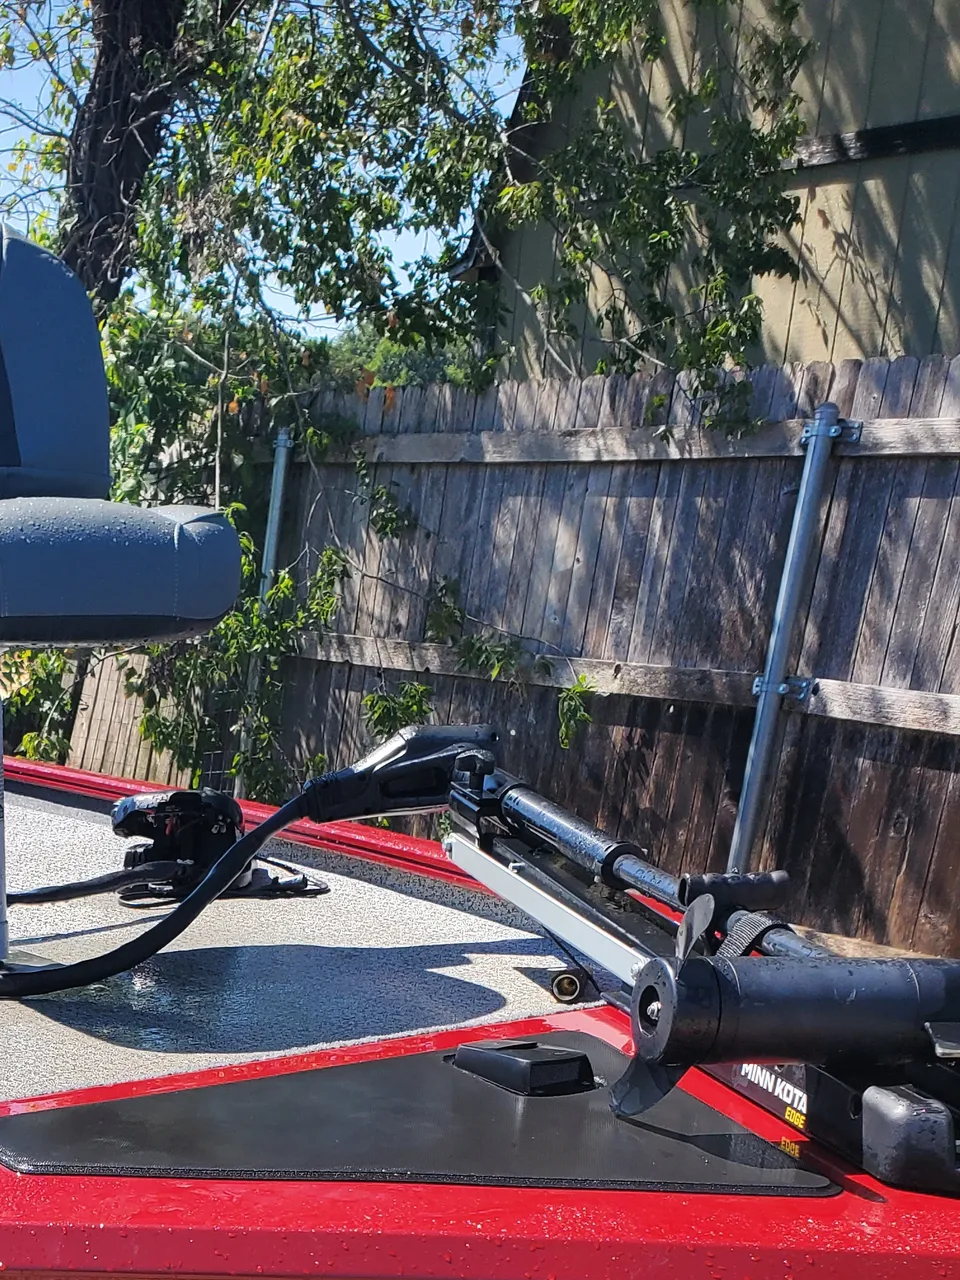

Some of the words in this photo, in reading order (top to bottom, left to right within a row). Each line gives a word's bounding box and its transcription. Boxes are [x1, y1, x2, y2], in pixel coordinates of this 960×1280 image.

[741, 1064, 775, 1092] MINN
[774, 1078, 808, 1114] KOTA
[784, 1106, 806, 1129] EDGE
